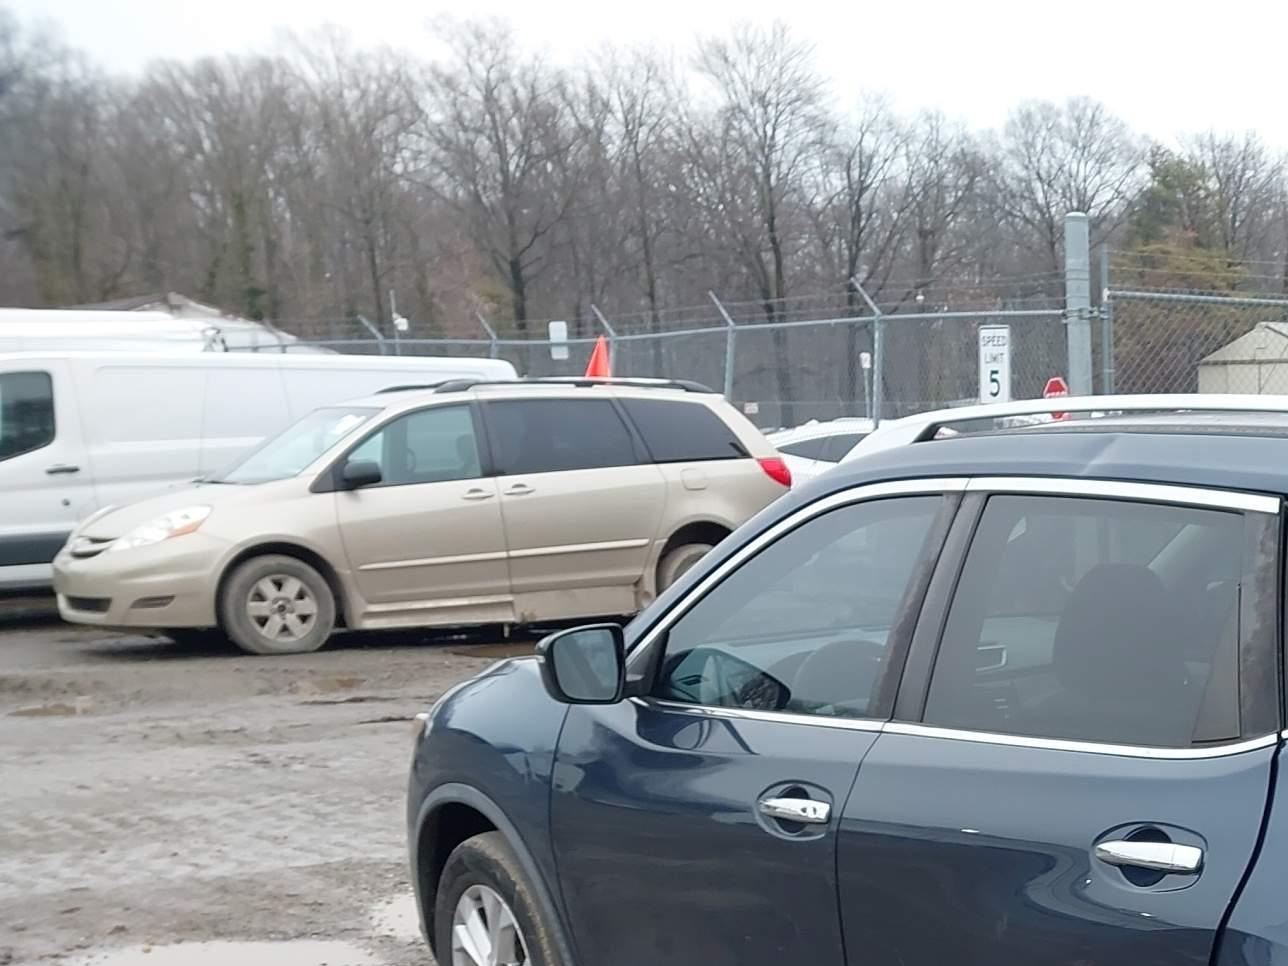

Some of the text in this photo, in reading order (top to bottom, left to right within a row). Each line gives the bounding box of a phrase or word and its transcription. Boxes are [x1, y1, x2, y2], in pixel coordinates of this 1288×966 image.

[981, 335, 1007, 347] SPEED
[984, 352, 1005, 364] LIMIT
[989, 369, 1001, 398] 5
